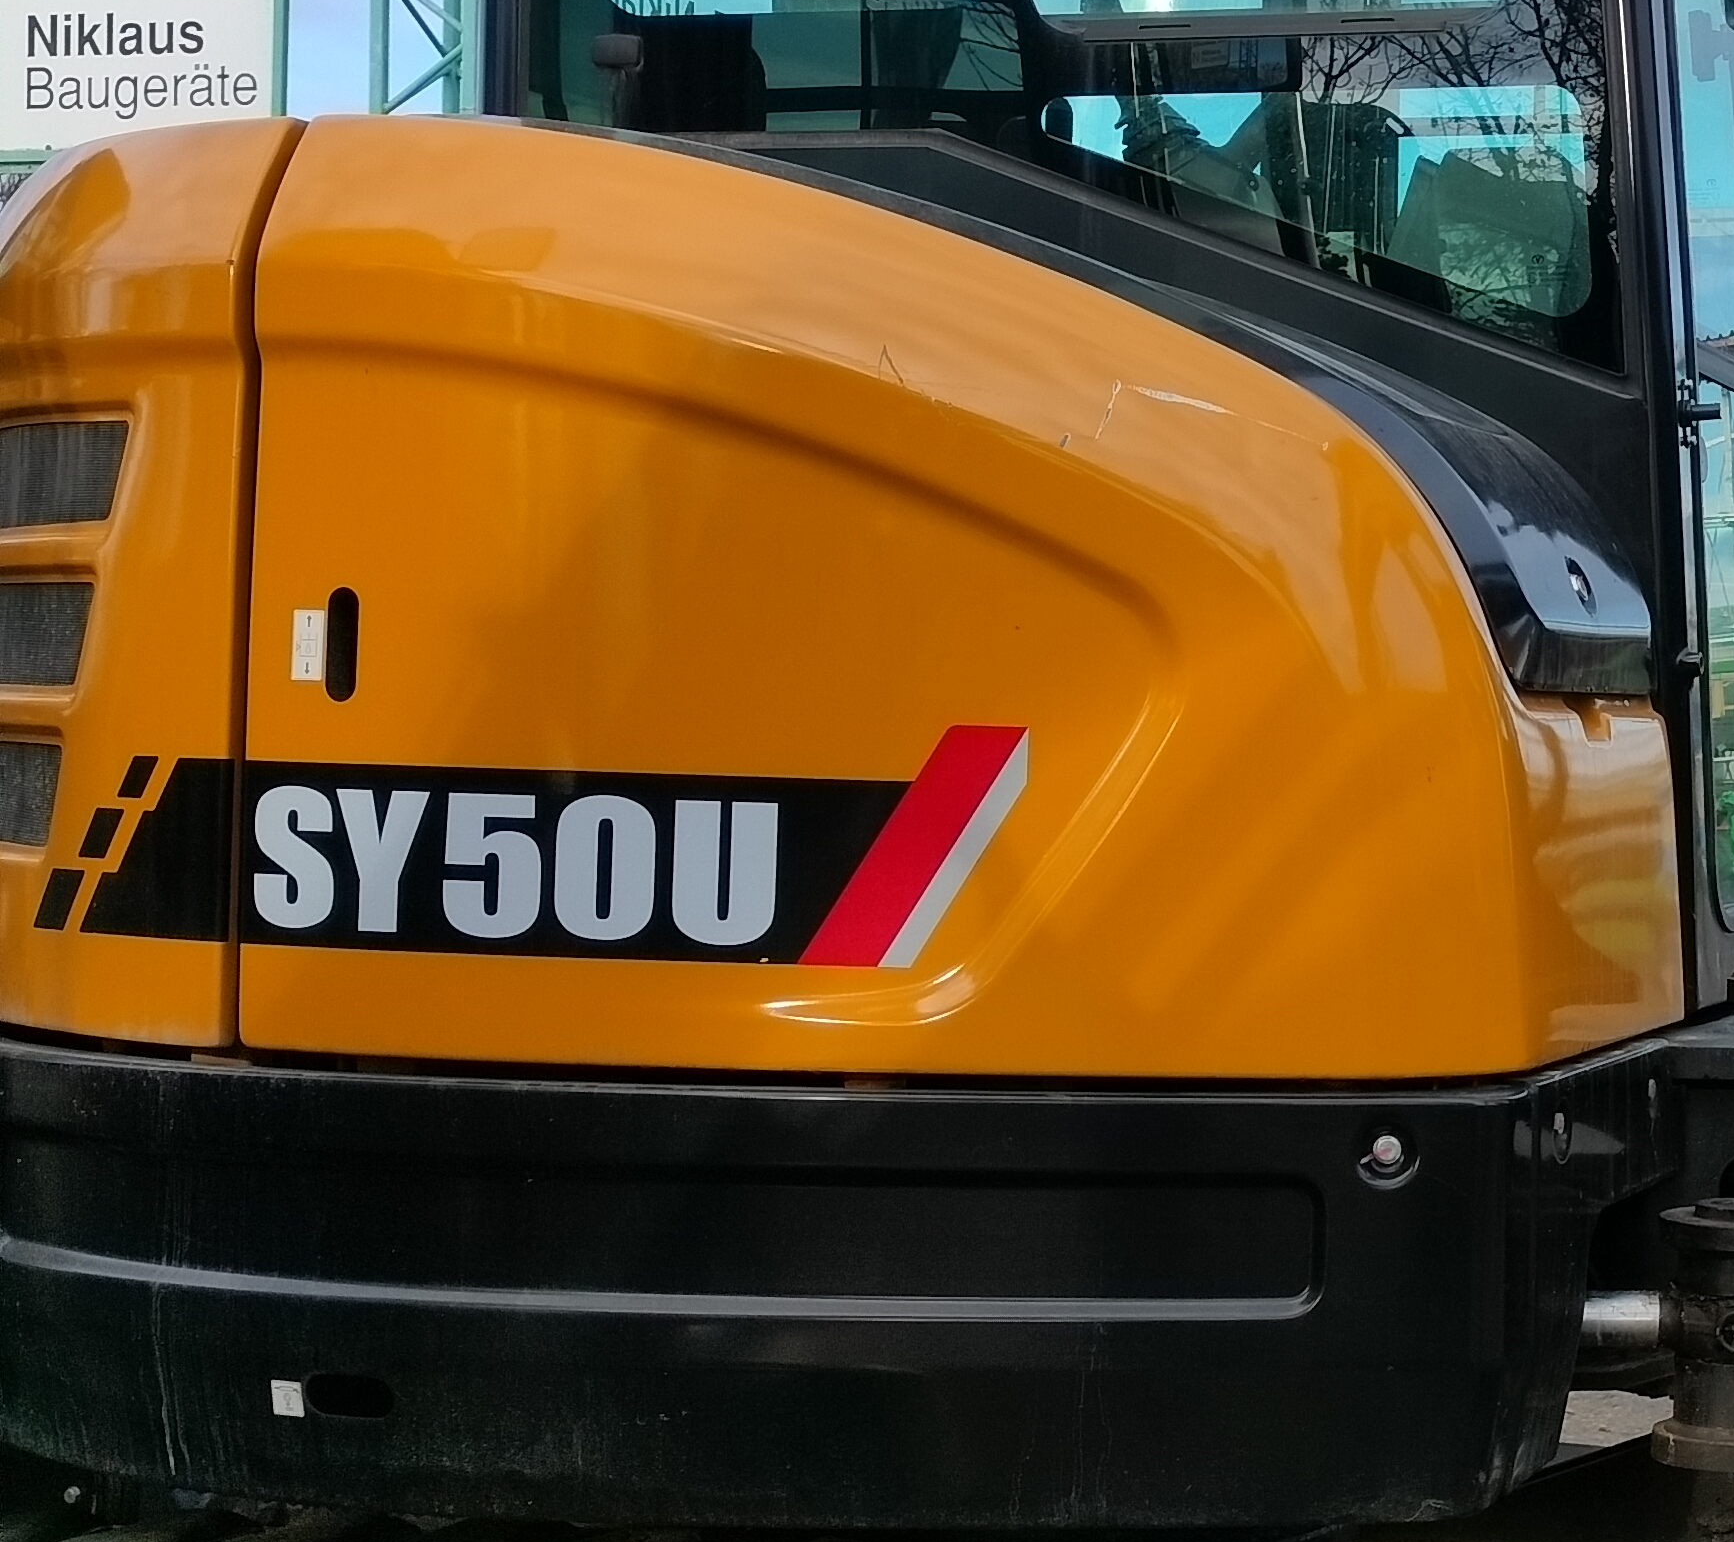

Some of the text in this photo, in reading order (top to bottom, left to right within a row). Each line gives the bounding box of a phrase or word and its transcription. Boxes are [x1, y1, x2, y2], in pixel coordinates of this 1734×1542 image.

[27, 12, 205, 58] Niklaus
[26, 65, 259, 120] Baugeräte
[252, 784, 779, 947] SY50U
